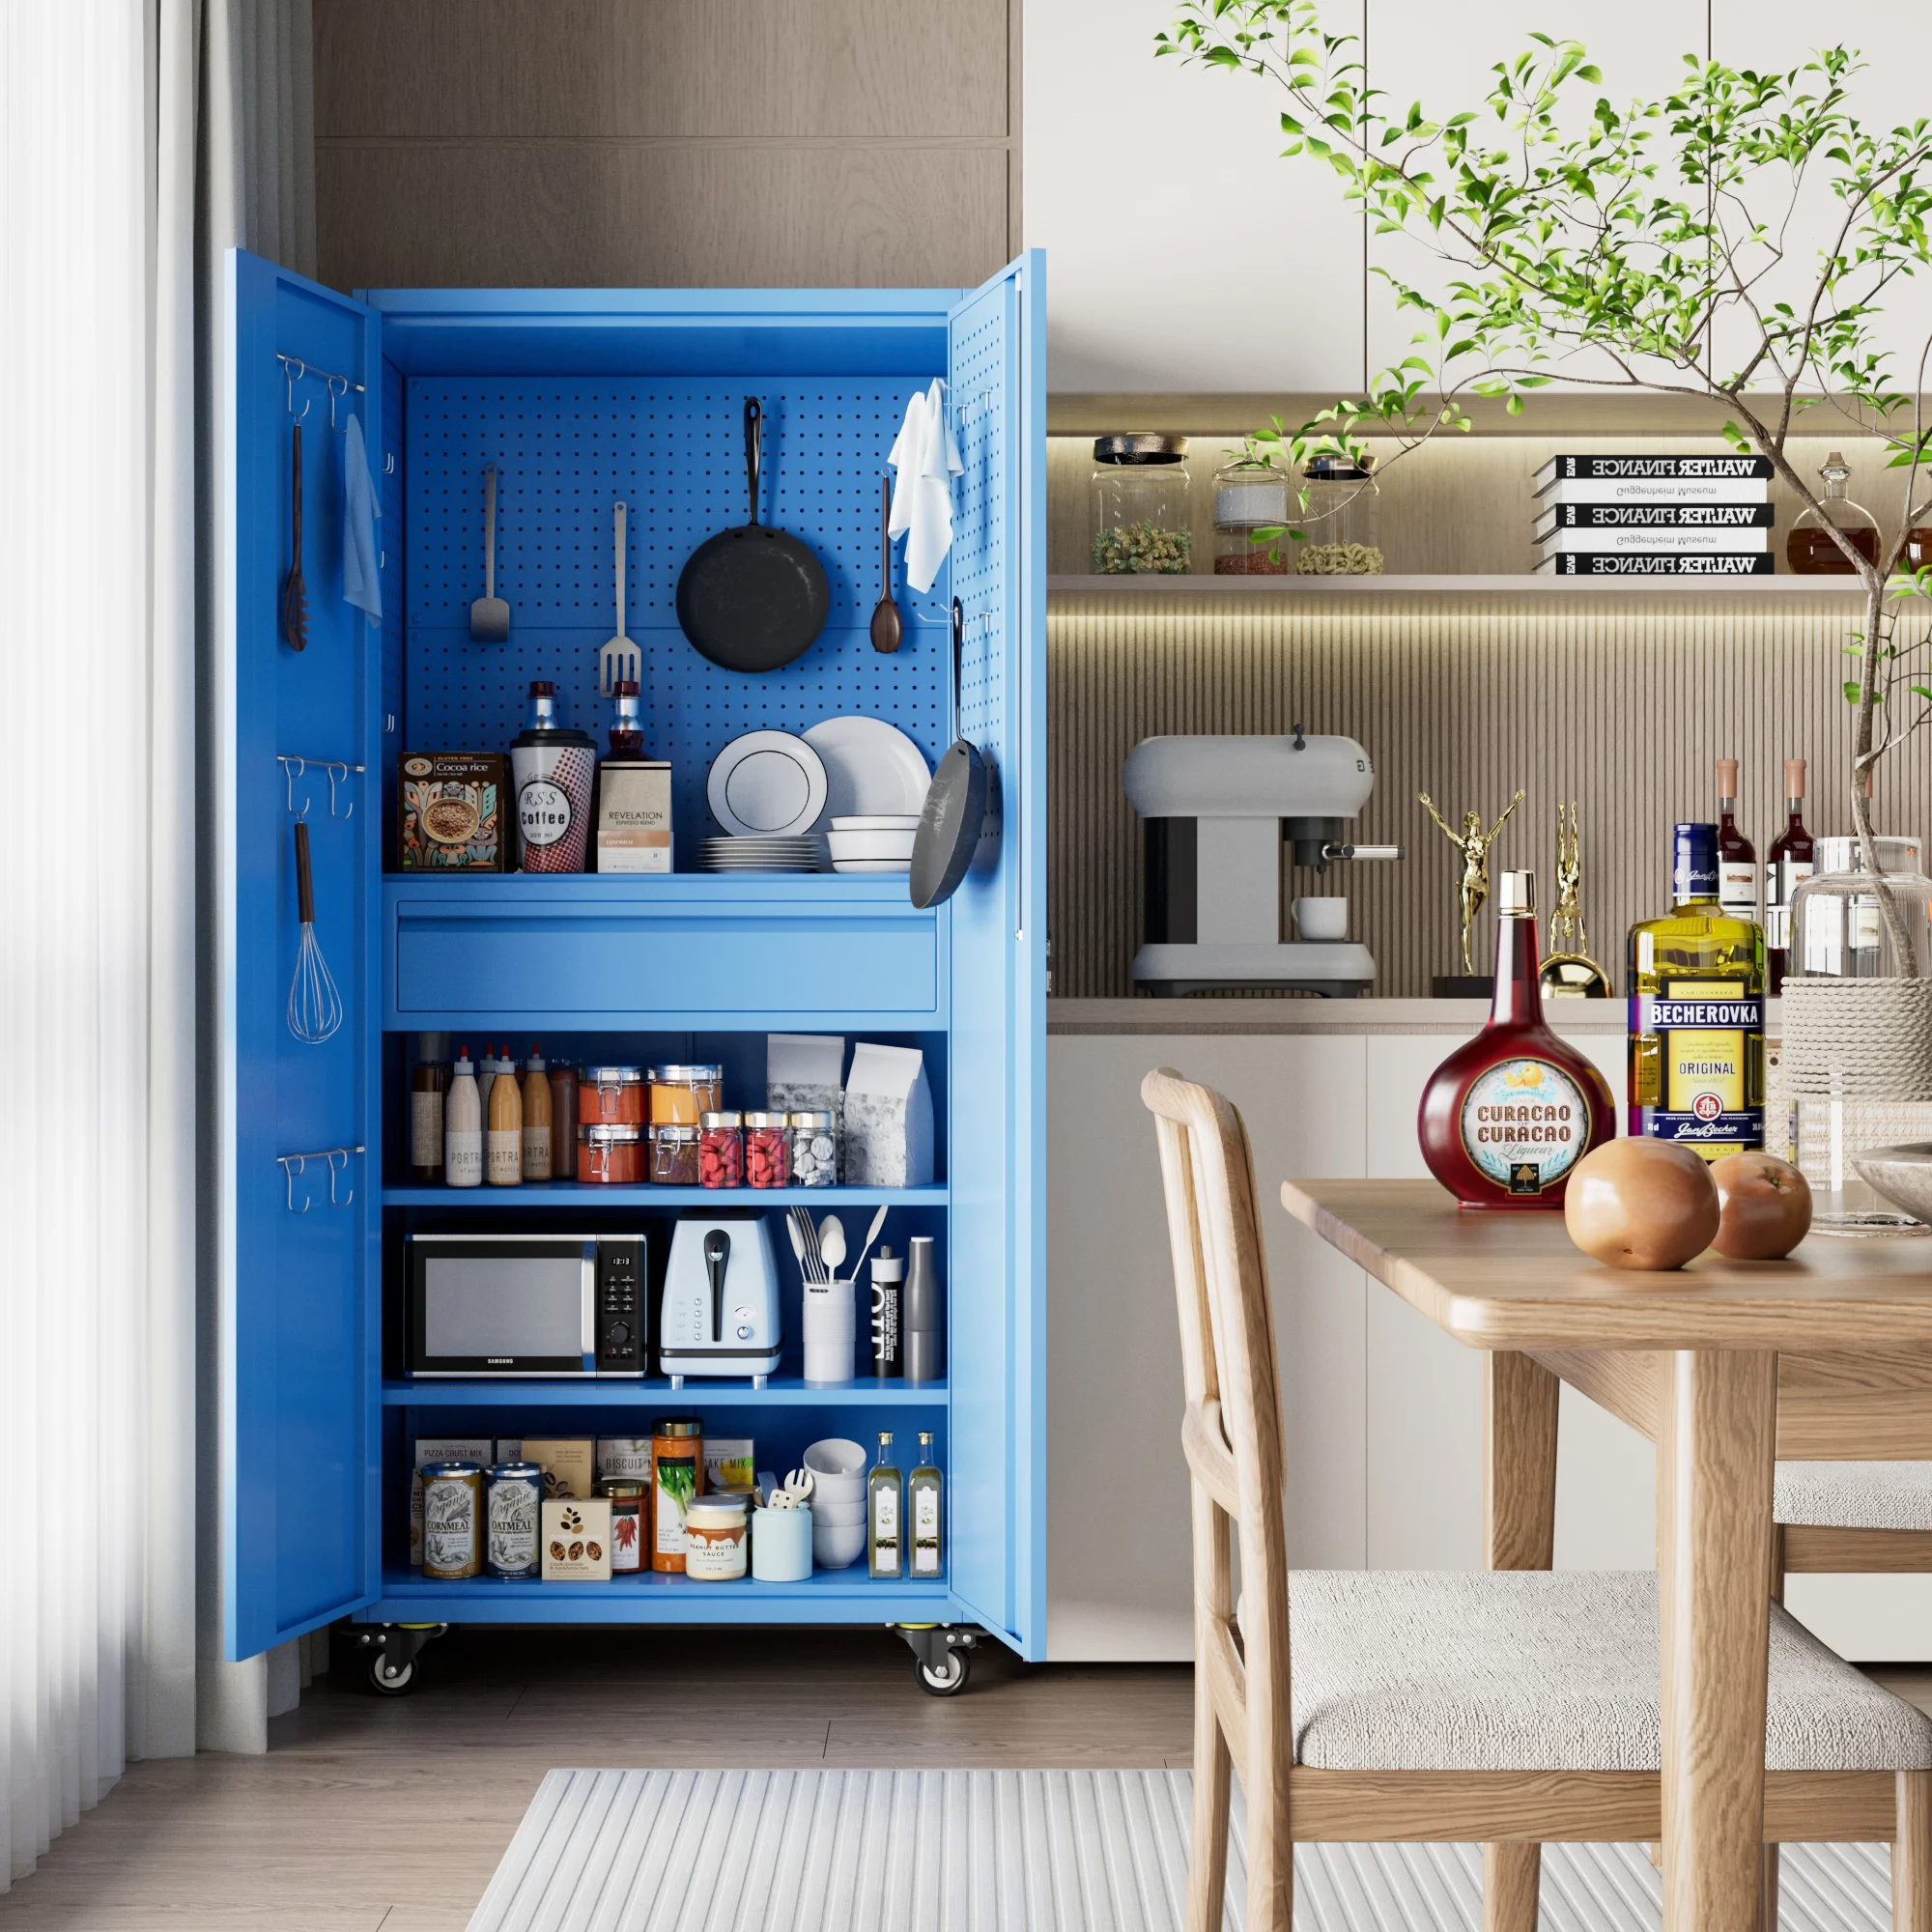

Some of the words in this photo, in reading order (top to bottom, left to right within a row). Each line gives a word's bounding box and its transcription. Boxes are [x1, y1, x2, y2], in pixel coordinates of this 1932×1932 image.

[436, 762, 468, 772] Cocoa
[469, 762, 489, 772] rice
[522, 811, 565, 825] Coffee
[609, 811, 663, 820] REVELATION
[1651, 1005, 1758, 1023] BECHEROVKA
[1679, 1063, 1736, 1074] ORIGINAL
[1477, 1105, 1572, 1122] CURACAO
[1477, 1125, 1572, 1143] CURACAO
[523, 1147, 549, 1158] ORTRA
[1499, 1143, 1555, 1161] Liqueur
[606, 1458, 641, 1469] BISCUIT
[729, 1458, 746, 1468] MIX
[427, 1520, 470, 1531] CORNMEAL
[491, 1520, 533, 1531] OATMEAL
